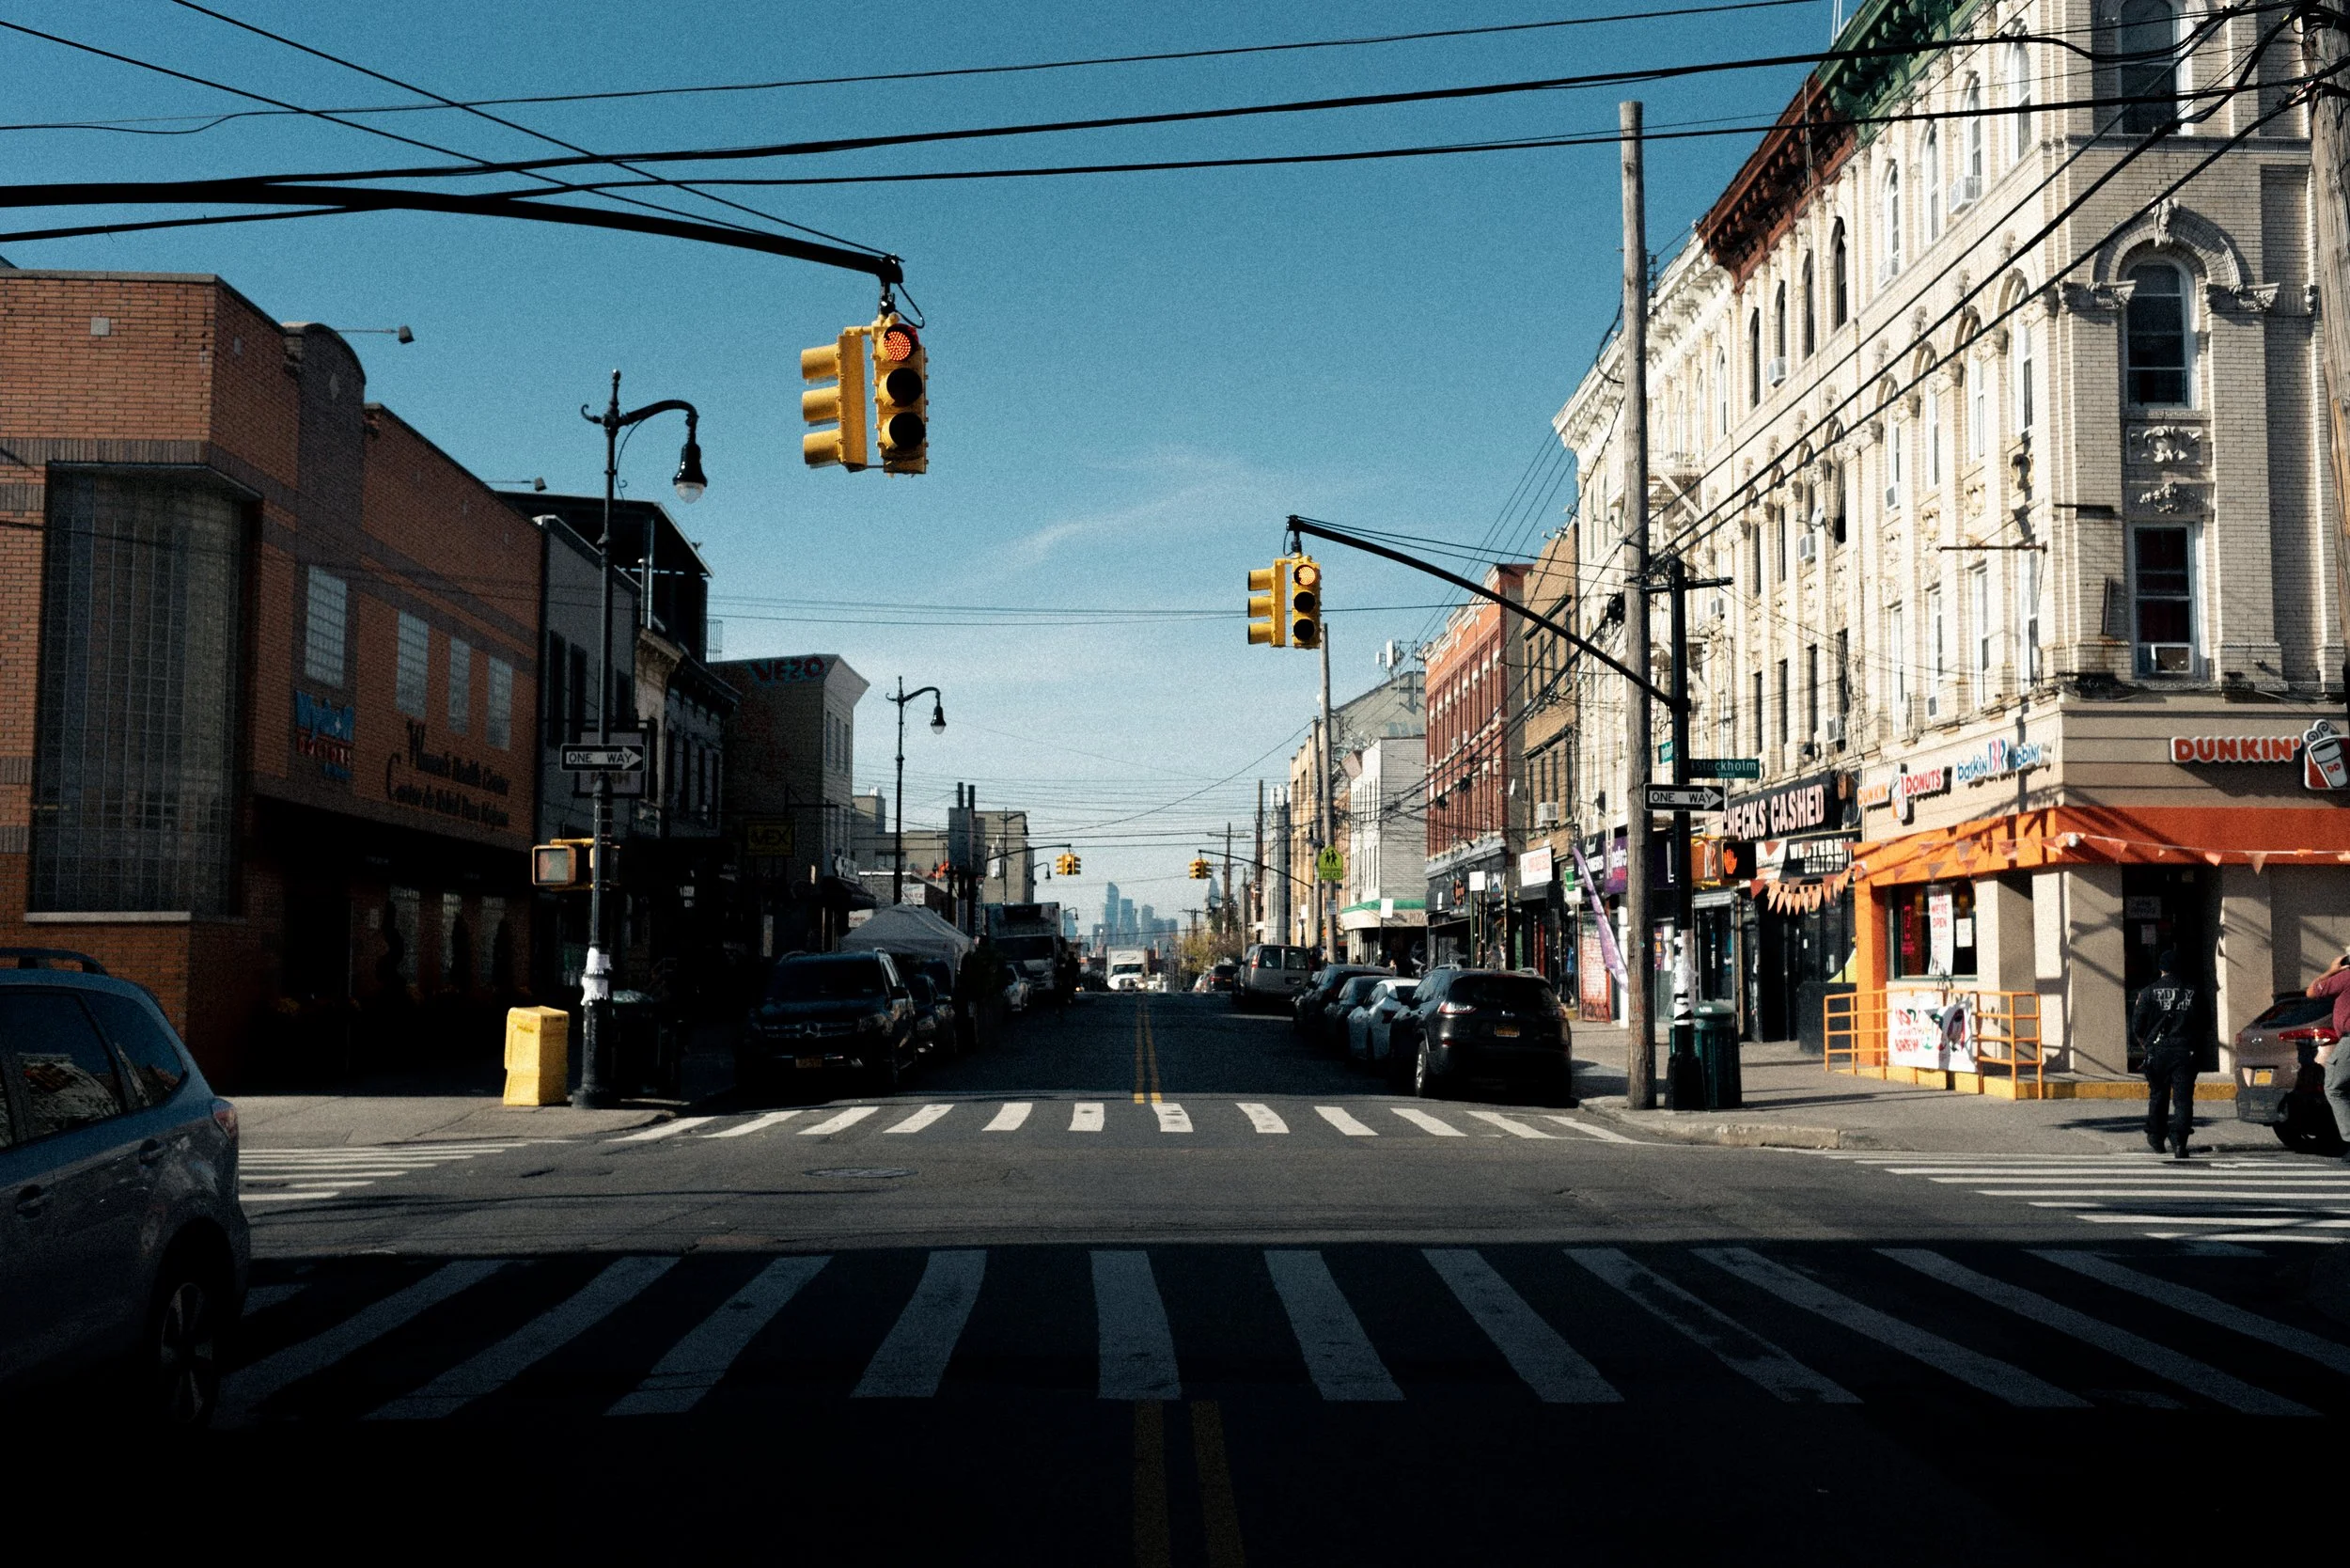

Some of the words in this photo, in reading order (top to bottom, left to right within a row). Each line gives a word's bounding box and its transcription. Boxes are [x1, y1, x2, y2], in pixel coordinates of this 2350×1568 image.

[569, 753, 593, 763] ONE
[606, 753, 633, 763] WAY
[2174, 737, 2301, 761] DUNKIN'
[1696, 760, 1757, 771] Stockholm
[1957, 756, 1987, 780] baskin
[1905, 769, 1941, 793] DONUTS
[1652, 792, 1675, 803] ONE
[1688, 792, 1714, 804] WAY
[1857, 783, 1887, 805] DUNKIN
[1722, 798, 1767, 840] CHECKS
[1770, 784, 1825, 834] CASHED
[1804, 855, 1843, 874] UNION
